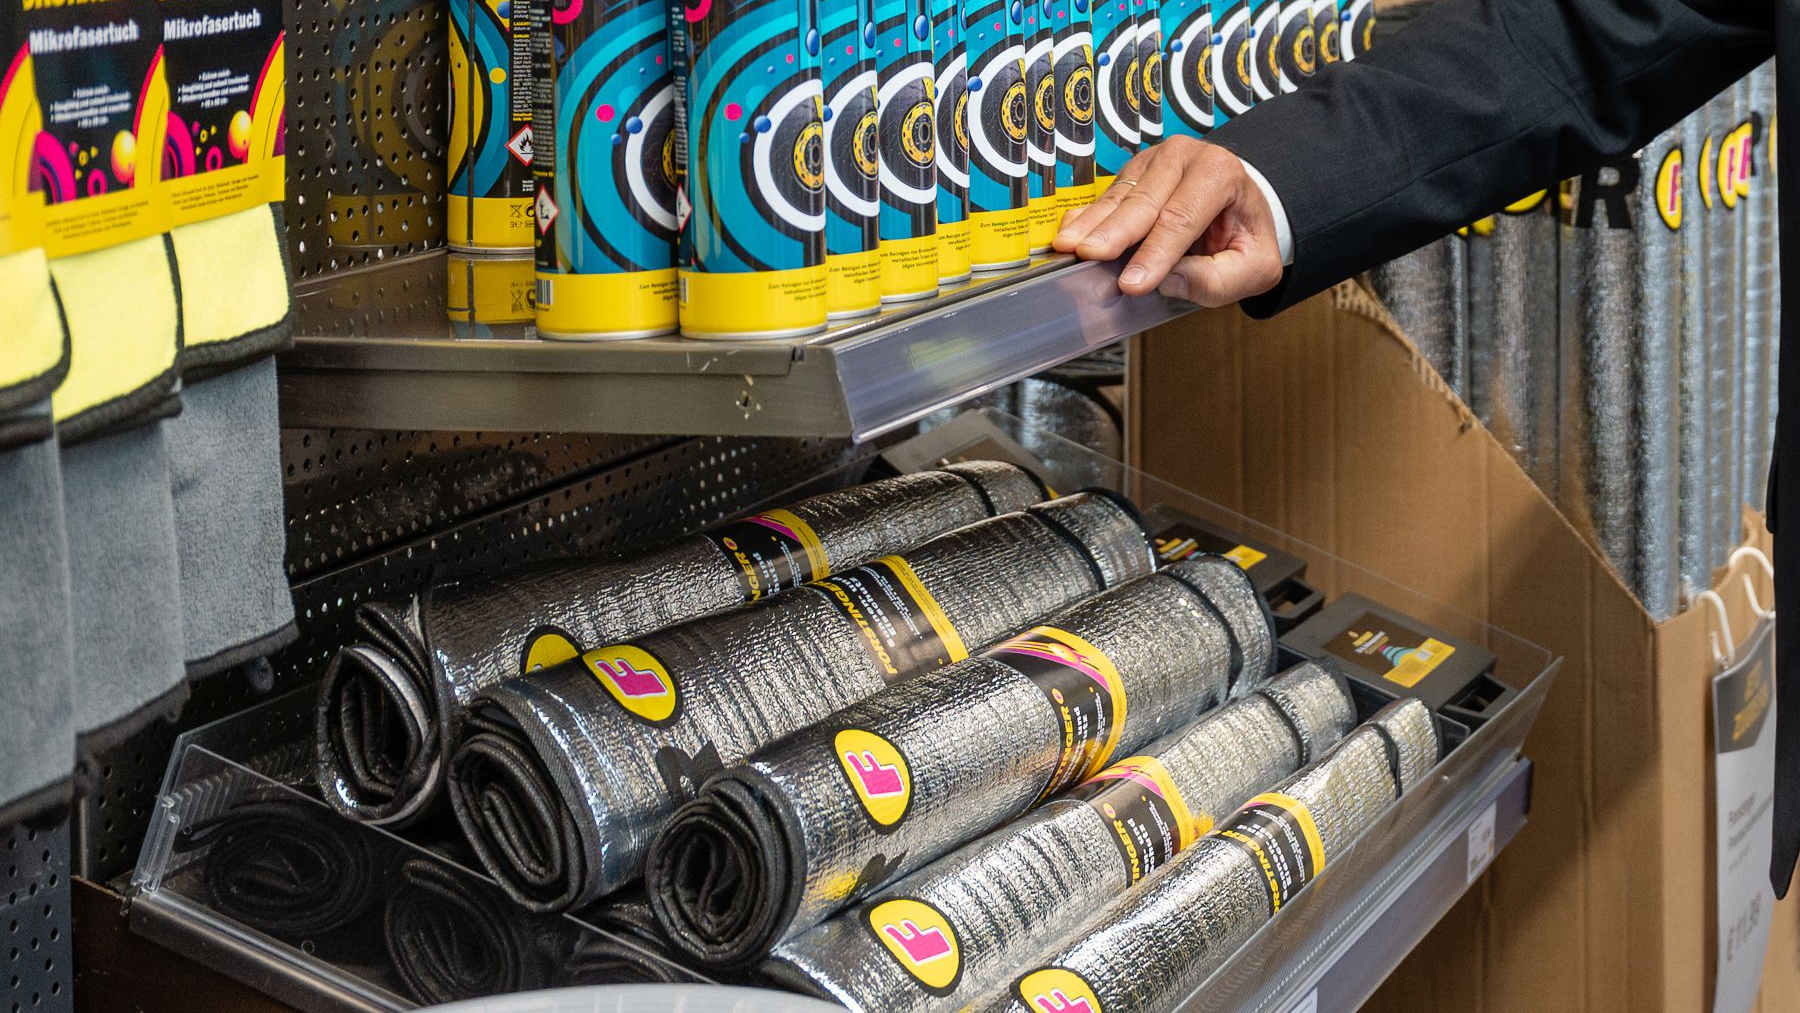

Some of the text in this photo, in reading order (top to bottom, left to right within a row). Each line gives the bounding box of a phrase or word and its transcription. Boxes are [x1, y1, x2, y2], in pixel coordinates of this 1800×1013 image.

[29, 17, 140, 55] Mikrofasertuch
[163, 6, 262, 43] Mikrofasertuch
[848, 576, 898, 637] Eisschutz
[857, 594, 897, 648] Sonnen-
[843, 748, 905, 800] F
[1265, 840, 1288, 901] Sonnen-
[882, 918, 953, 965] F
